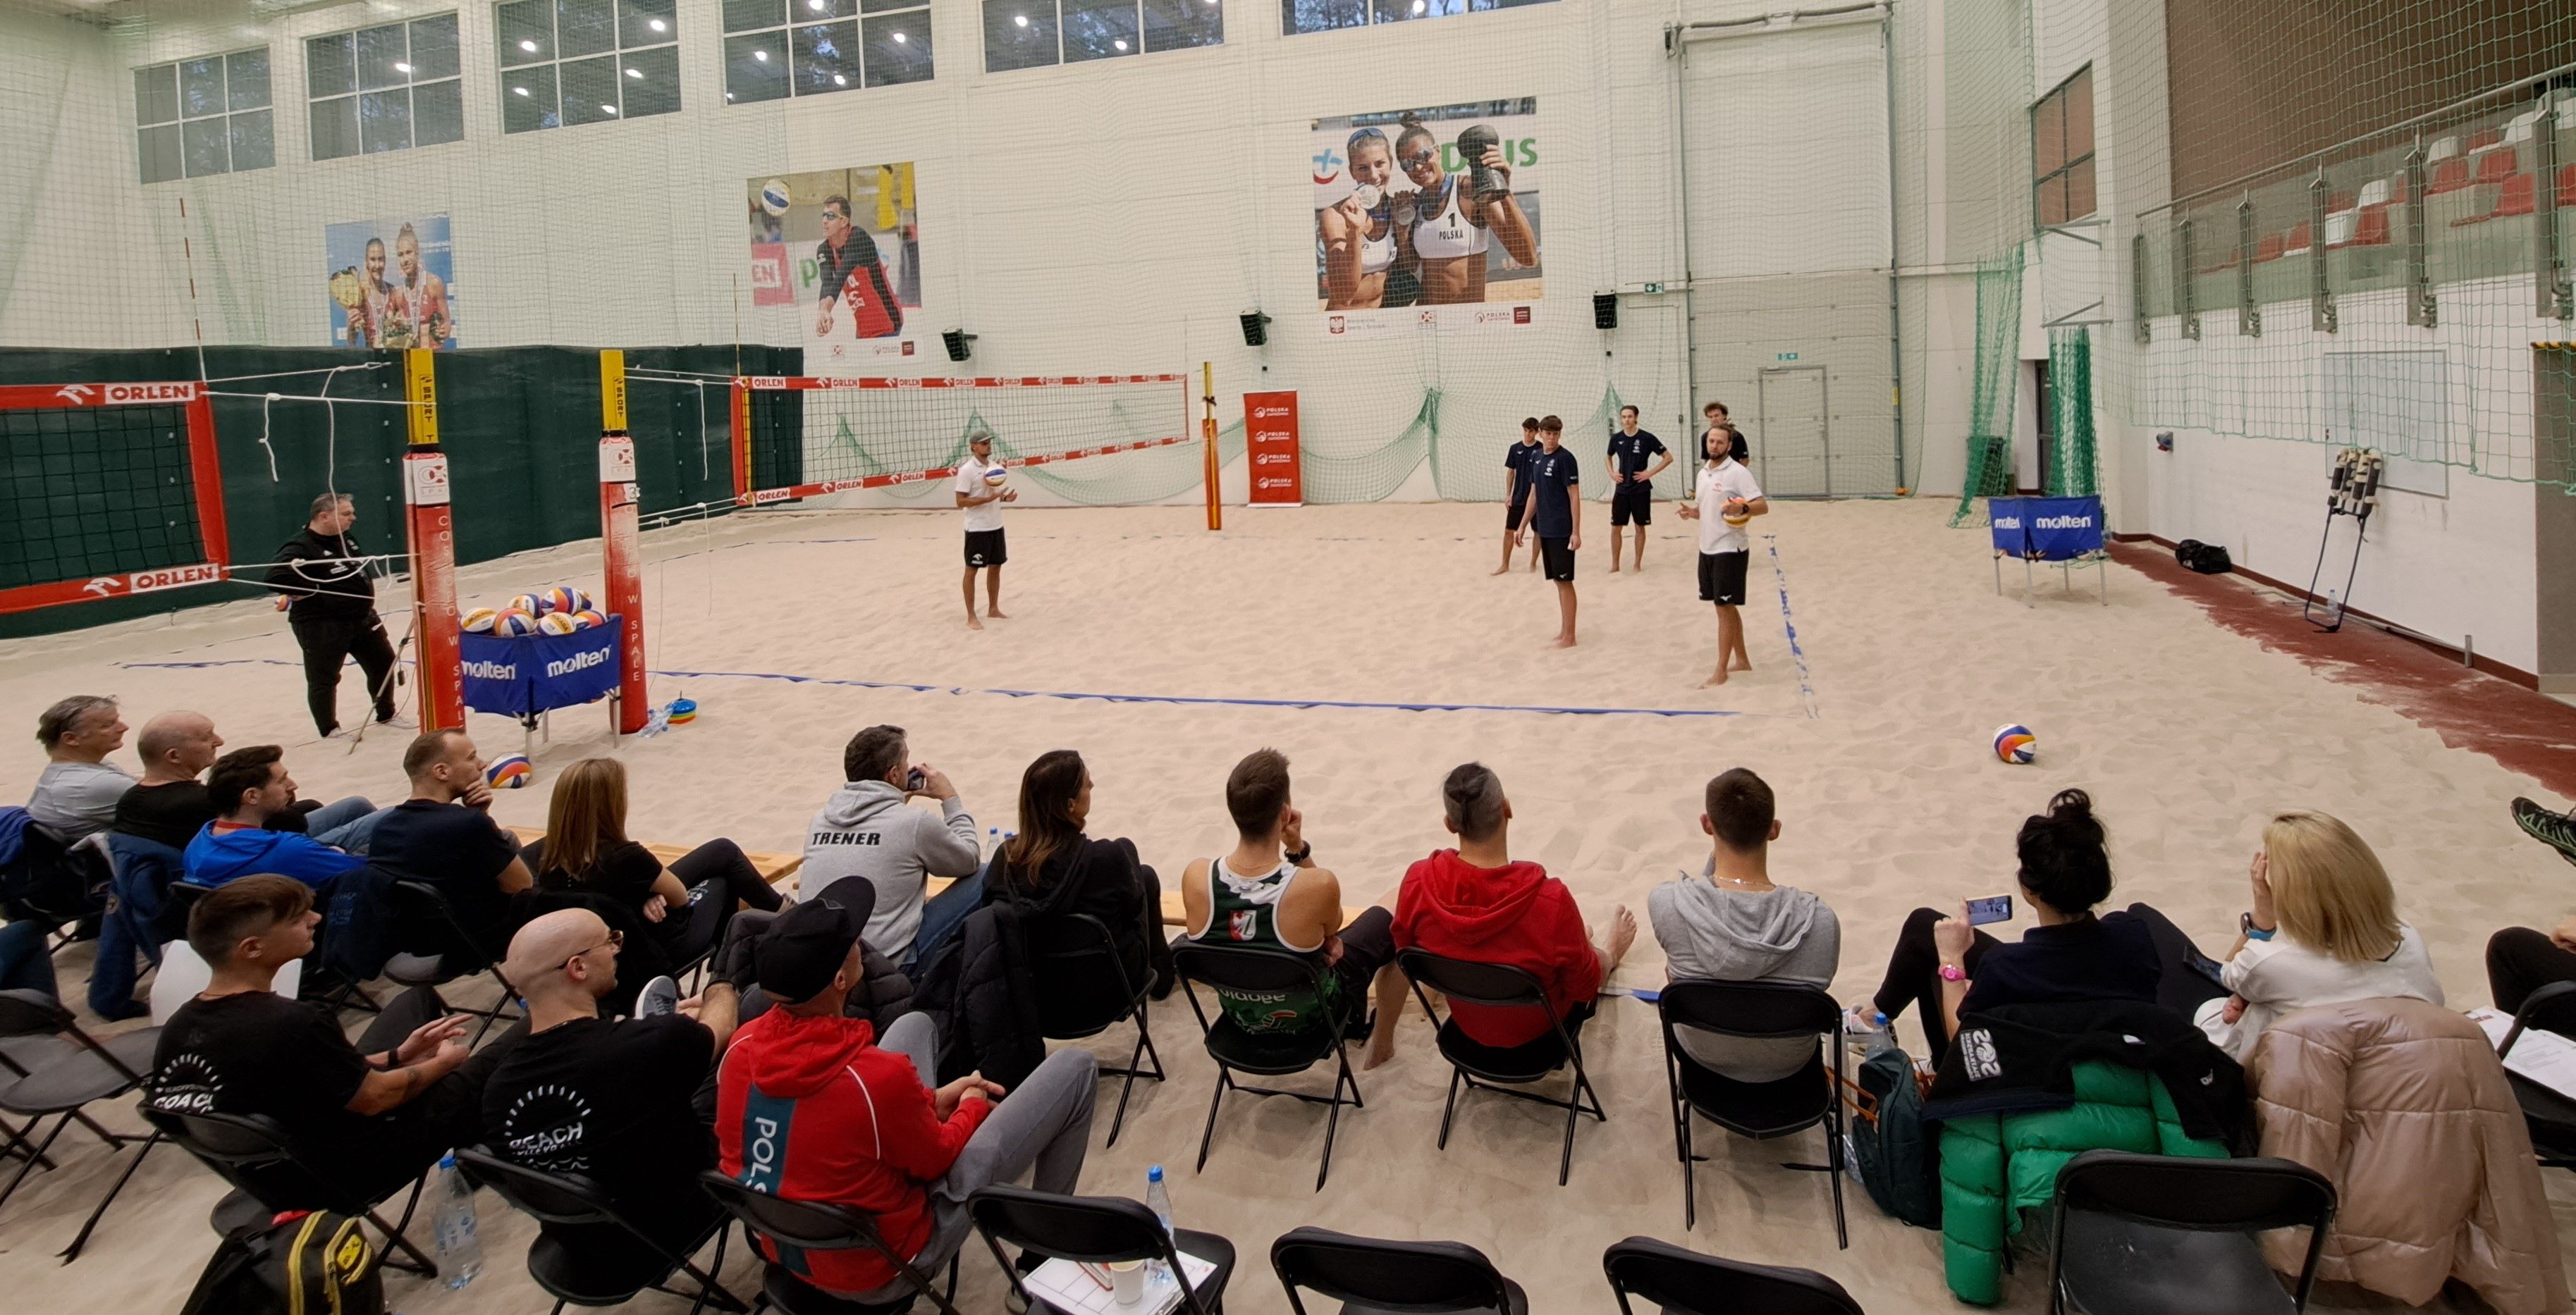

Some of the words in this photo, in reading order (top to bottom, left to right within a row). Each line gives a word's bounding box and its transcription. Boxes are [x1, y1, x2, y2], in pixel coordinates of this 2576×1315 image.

[1448, 212, 1456, 228] 1
[1439, 230, 1464, 240] POLSKA
[754, 378, 784, 387] ORLEN
[833, 378, 858, 387] ORLEN
[111, 385, 190, 401] ORLEN
[423, 386, 434, 423] SPORT
[758, 490, 788, 500] ORLEN
[837, 481, 861, 490] ORLEN
[902, 473, 925, 481] ORLEN
[2037, 514, 2092, 529] molten
[136, 567, 214, 589] ORLEN
[627, 595, 639, 604] W
[631, 620, 641, 681] SPALE
[547, 646, 611, 678] molten
[448, 636, 458, 647] W
[453, 665, 464, 728] SPAL
[812, 832, 881, 846] TRENER
